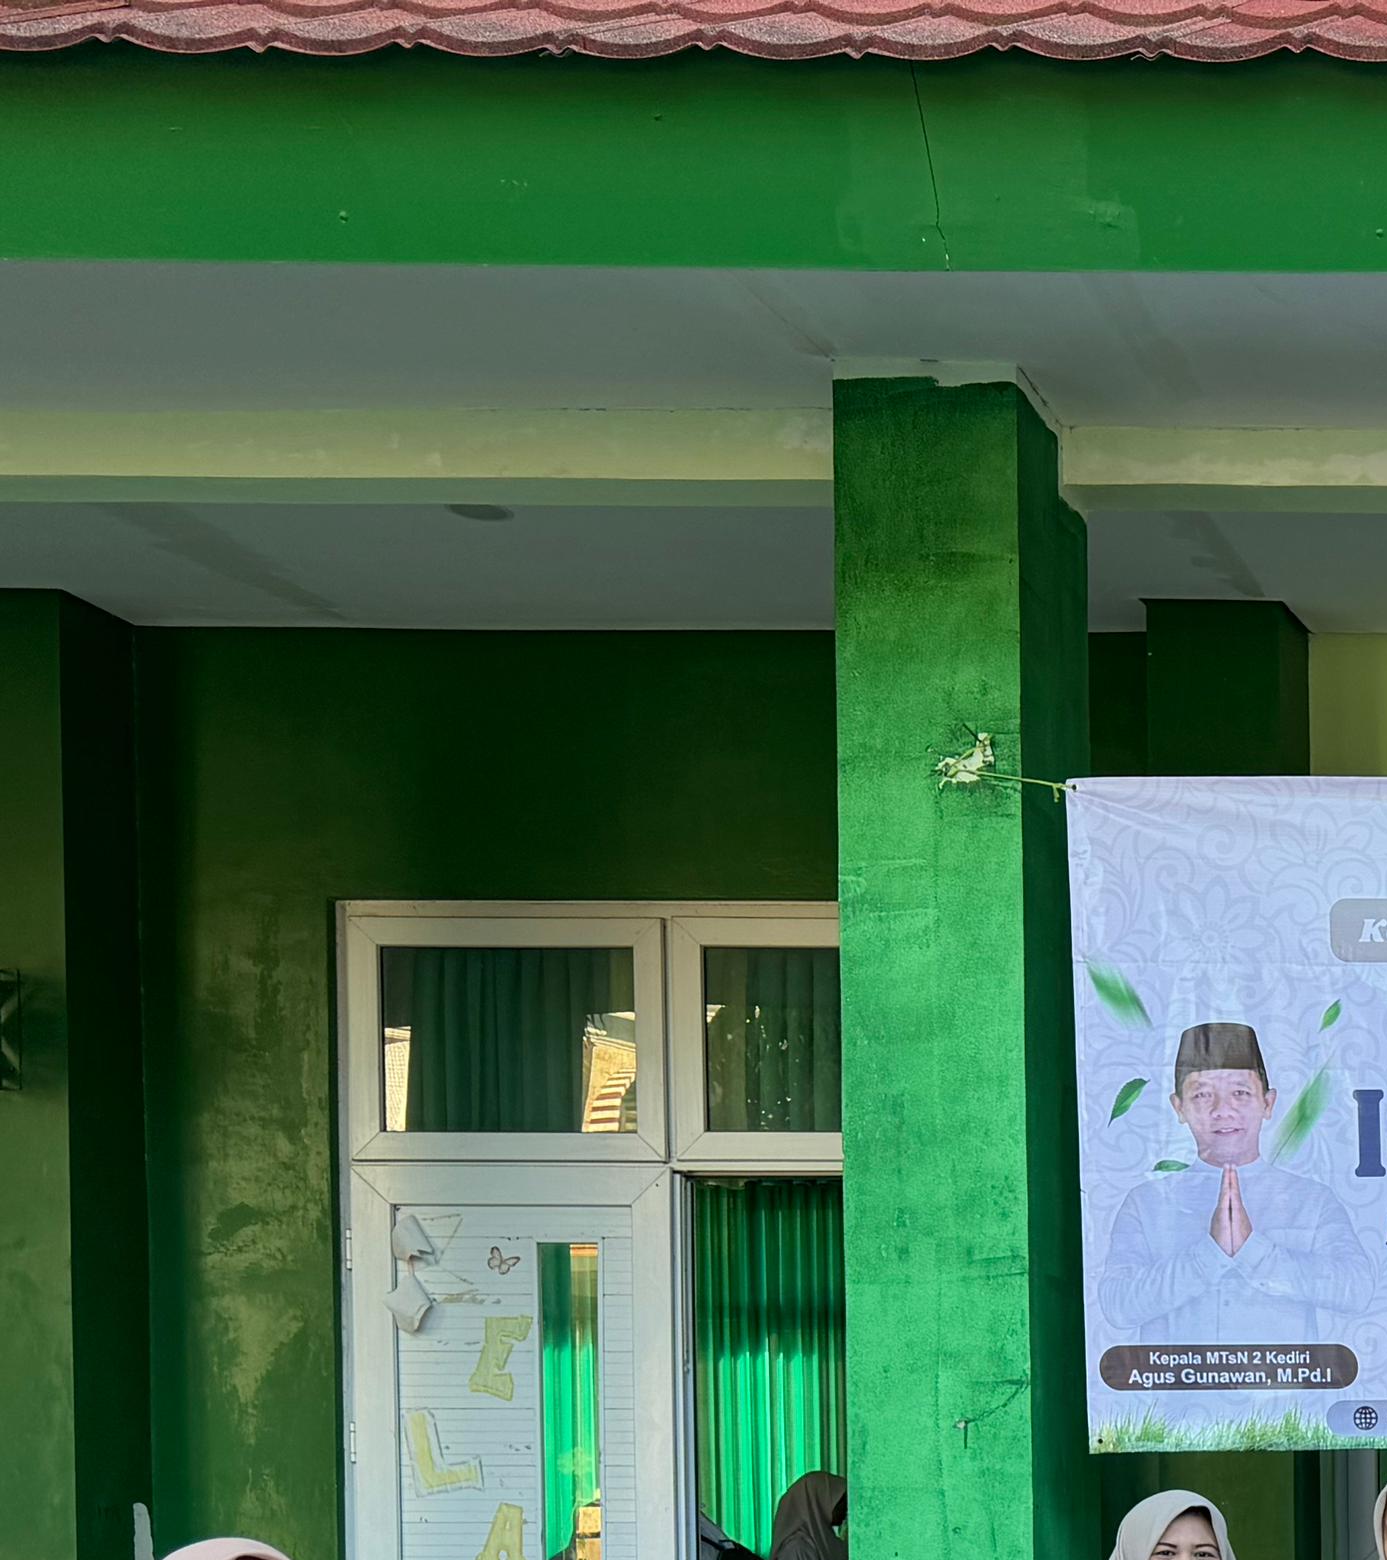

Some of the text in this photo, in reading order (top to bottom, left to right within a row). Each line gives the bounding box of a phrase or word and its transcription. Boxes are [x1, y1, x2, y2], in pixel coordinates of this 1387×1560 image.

[1149, 1351, 1310, 1368] Kepala MTsN 2 Kediri
[1128, 1369, 1176, 1388] Agus
[1180, 1368, 1271, 1385] Gunawan,
